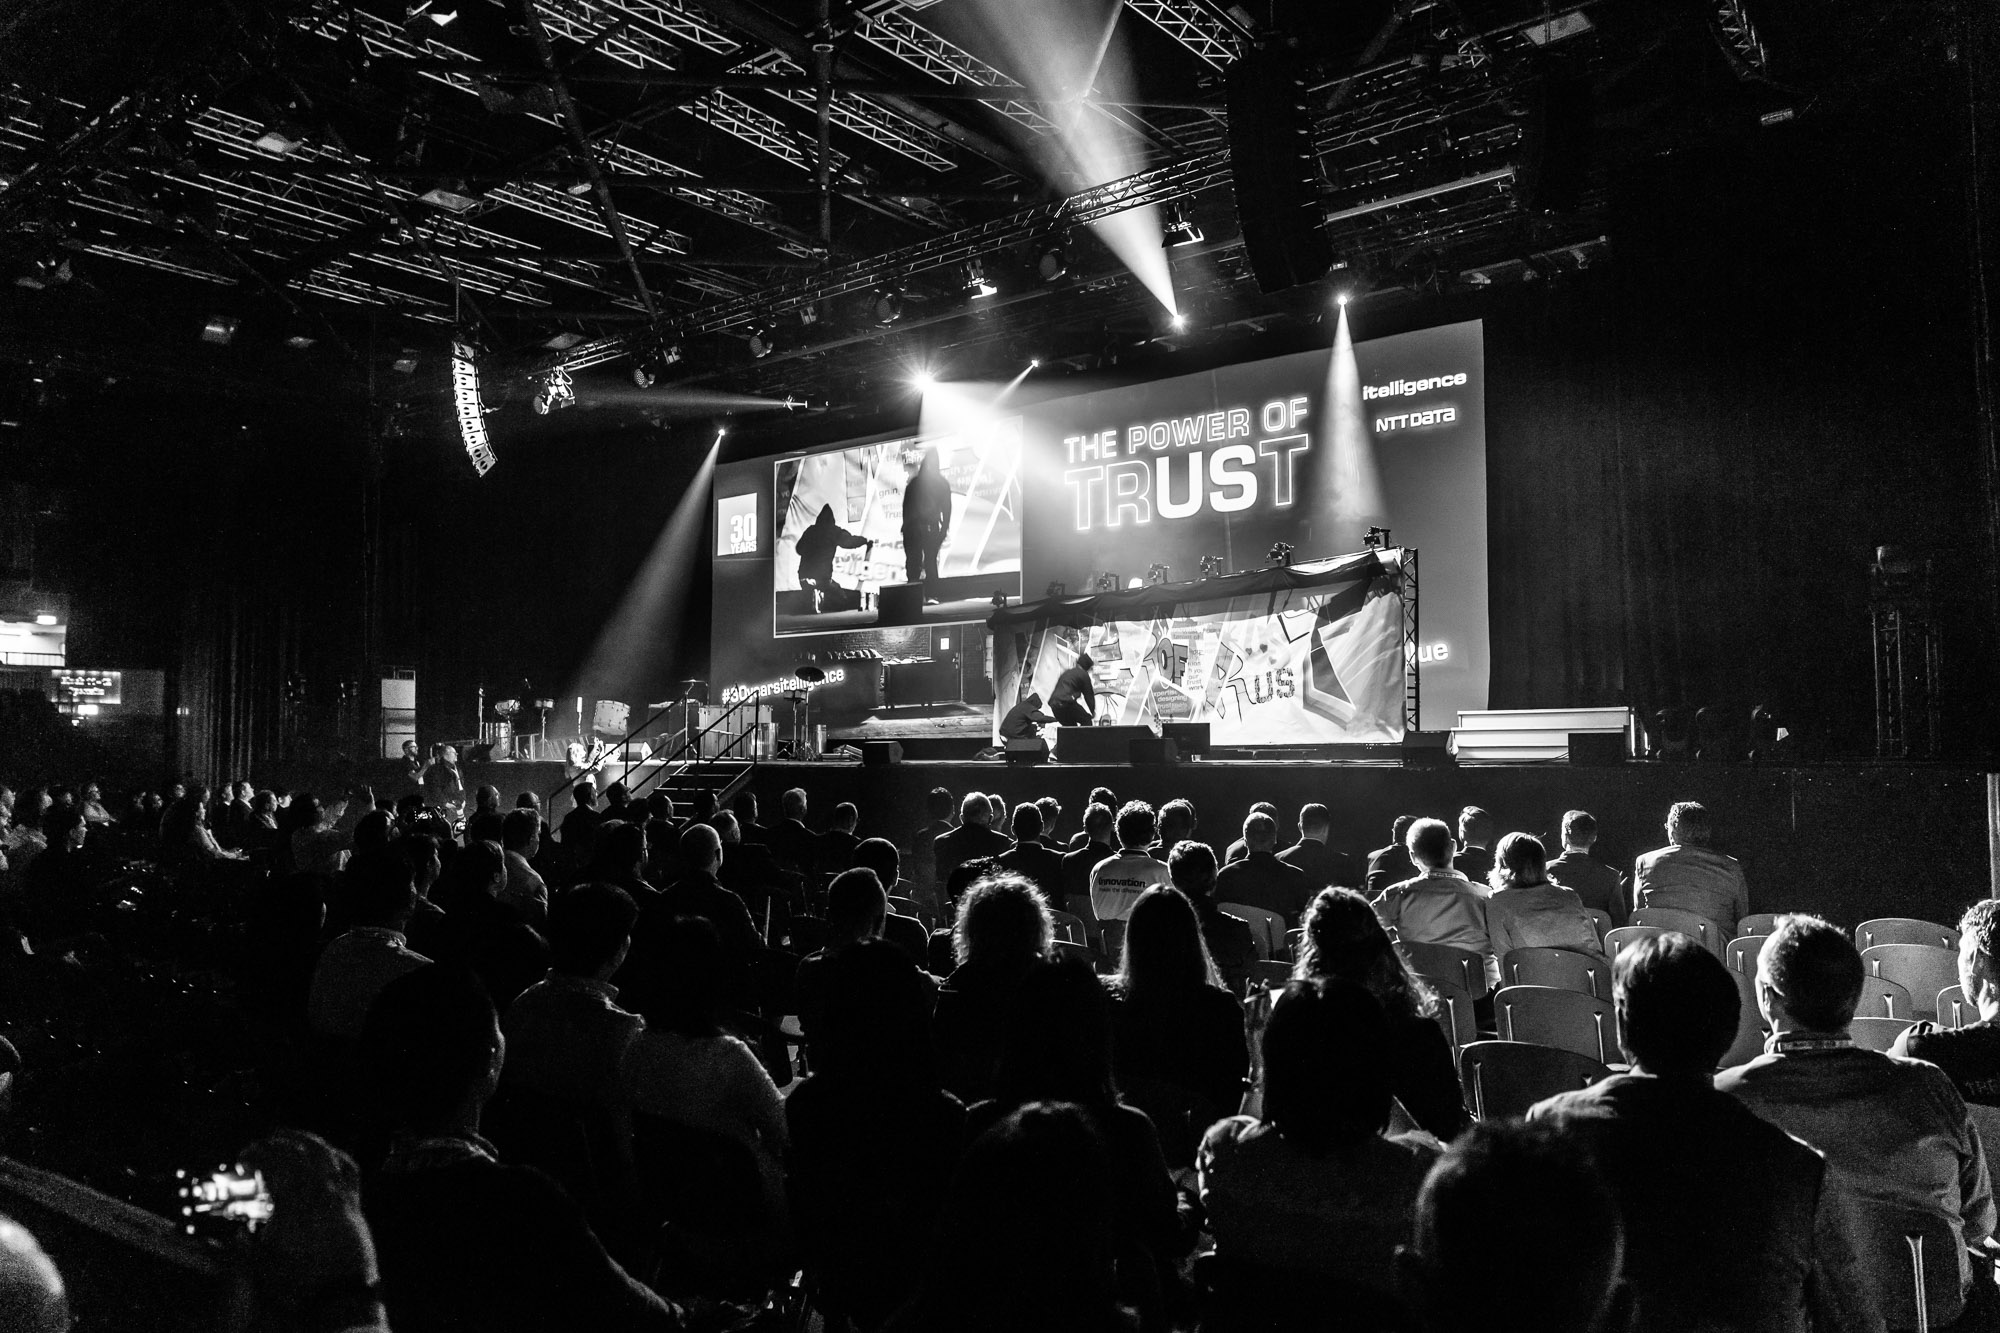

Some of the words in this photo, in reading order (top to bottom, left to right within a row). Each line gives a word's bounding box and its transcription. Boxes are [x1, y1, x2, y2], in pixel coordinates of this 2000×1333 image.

[1363, 372, 1467, 401] itelligence
[1064, 430, 1118, 463] THE
[1129, 408, 1250, 454] POWER
[1263, 397, 1309, 433] OF
[1064, 433, 1309, 531] TRUST
[730, 513, 757, 542] 30
[730, 540, 757, 554] YEARS
